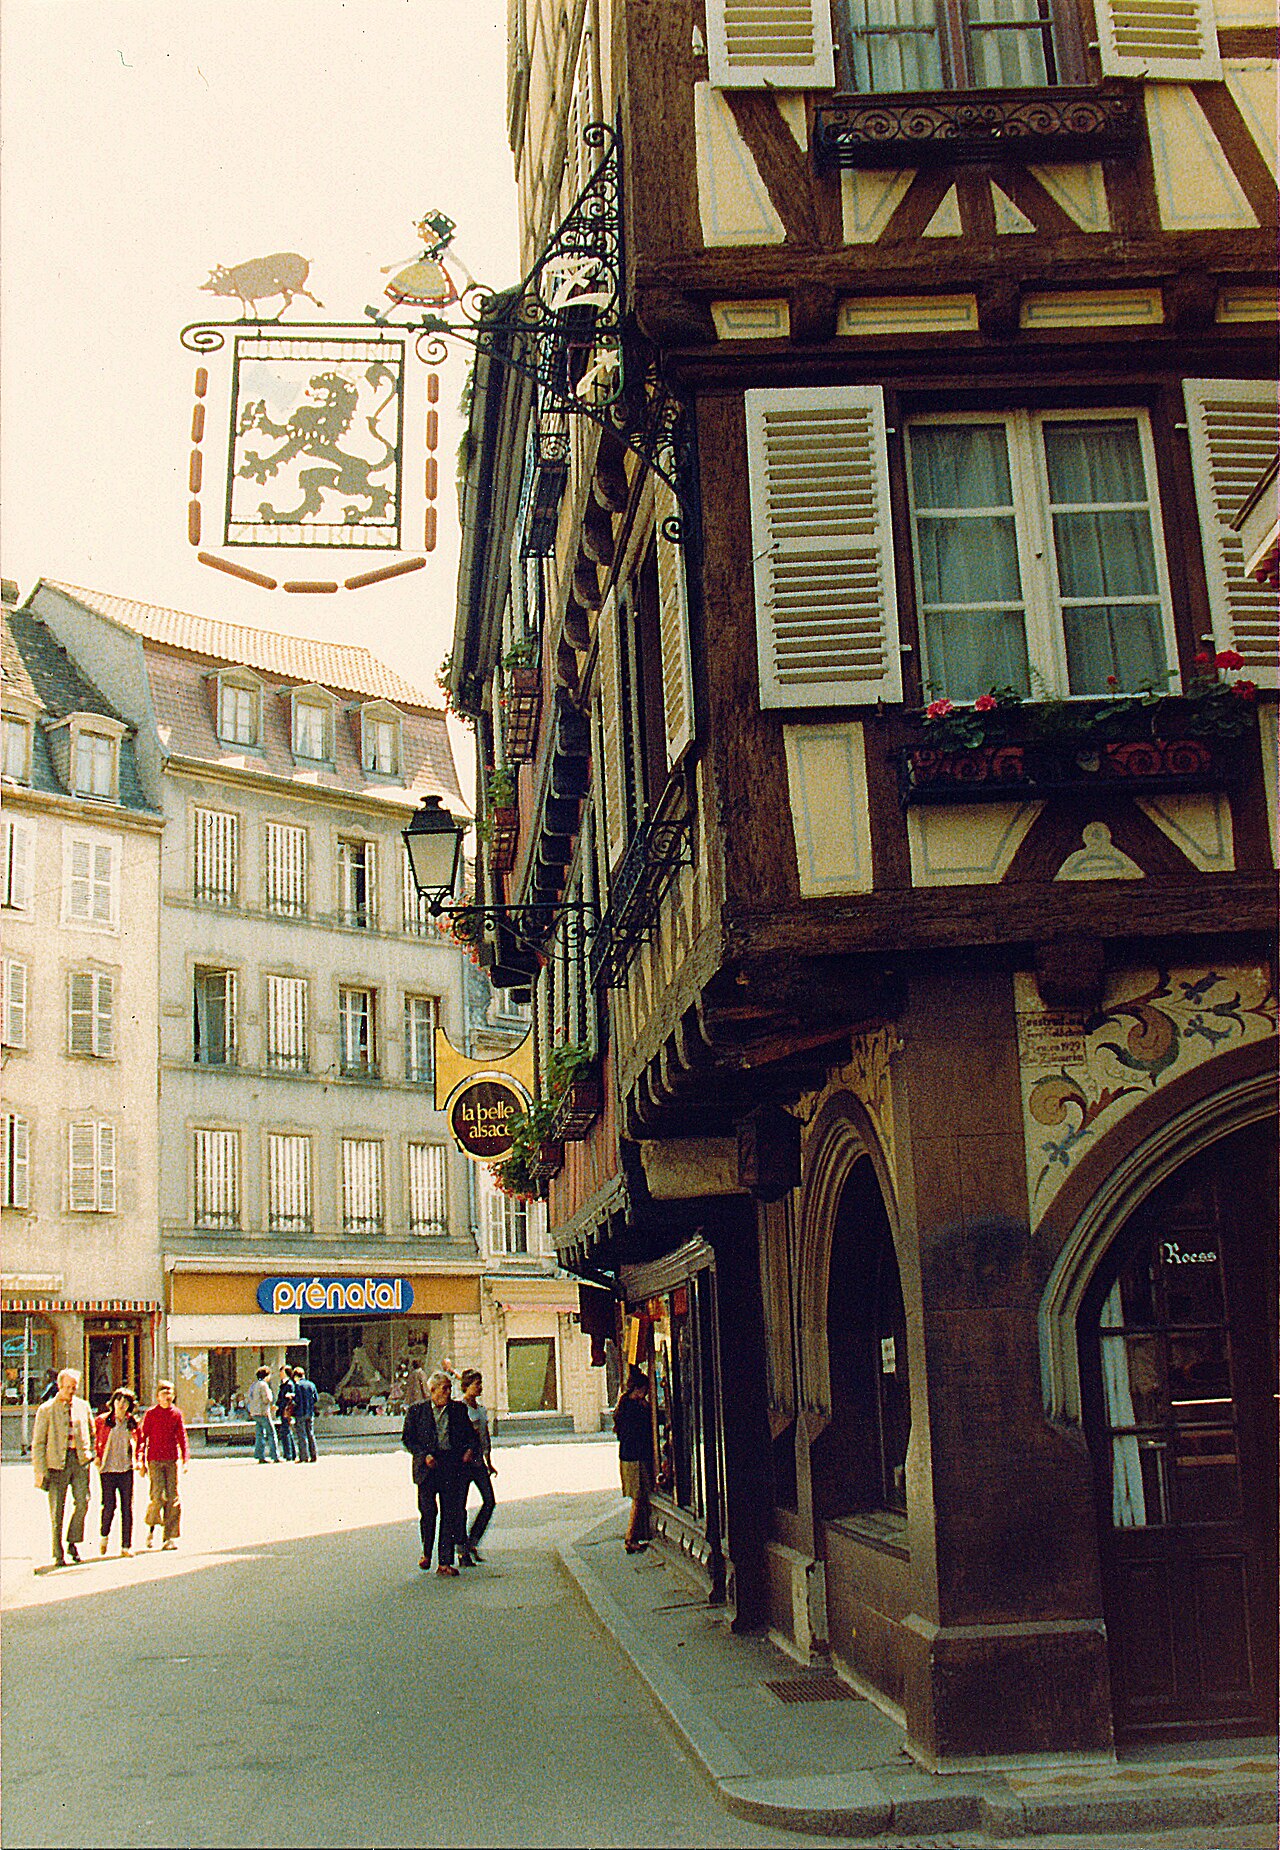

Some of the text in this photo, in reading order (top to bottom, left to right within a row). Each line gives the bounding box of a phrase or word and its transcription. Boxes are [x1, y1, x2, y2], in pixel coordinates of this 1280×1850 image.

[462, 1101, 514, 1121] la belle
[273, 1277, 402, 1313] prénatal
